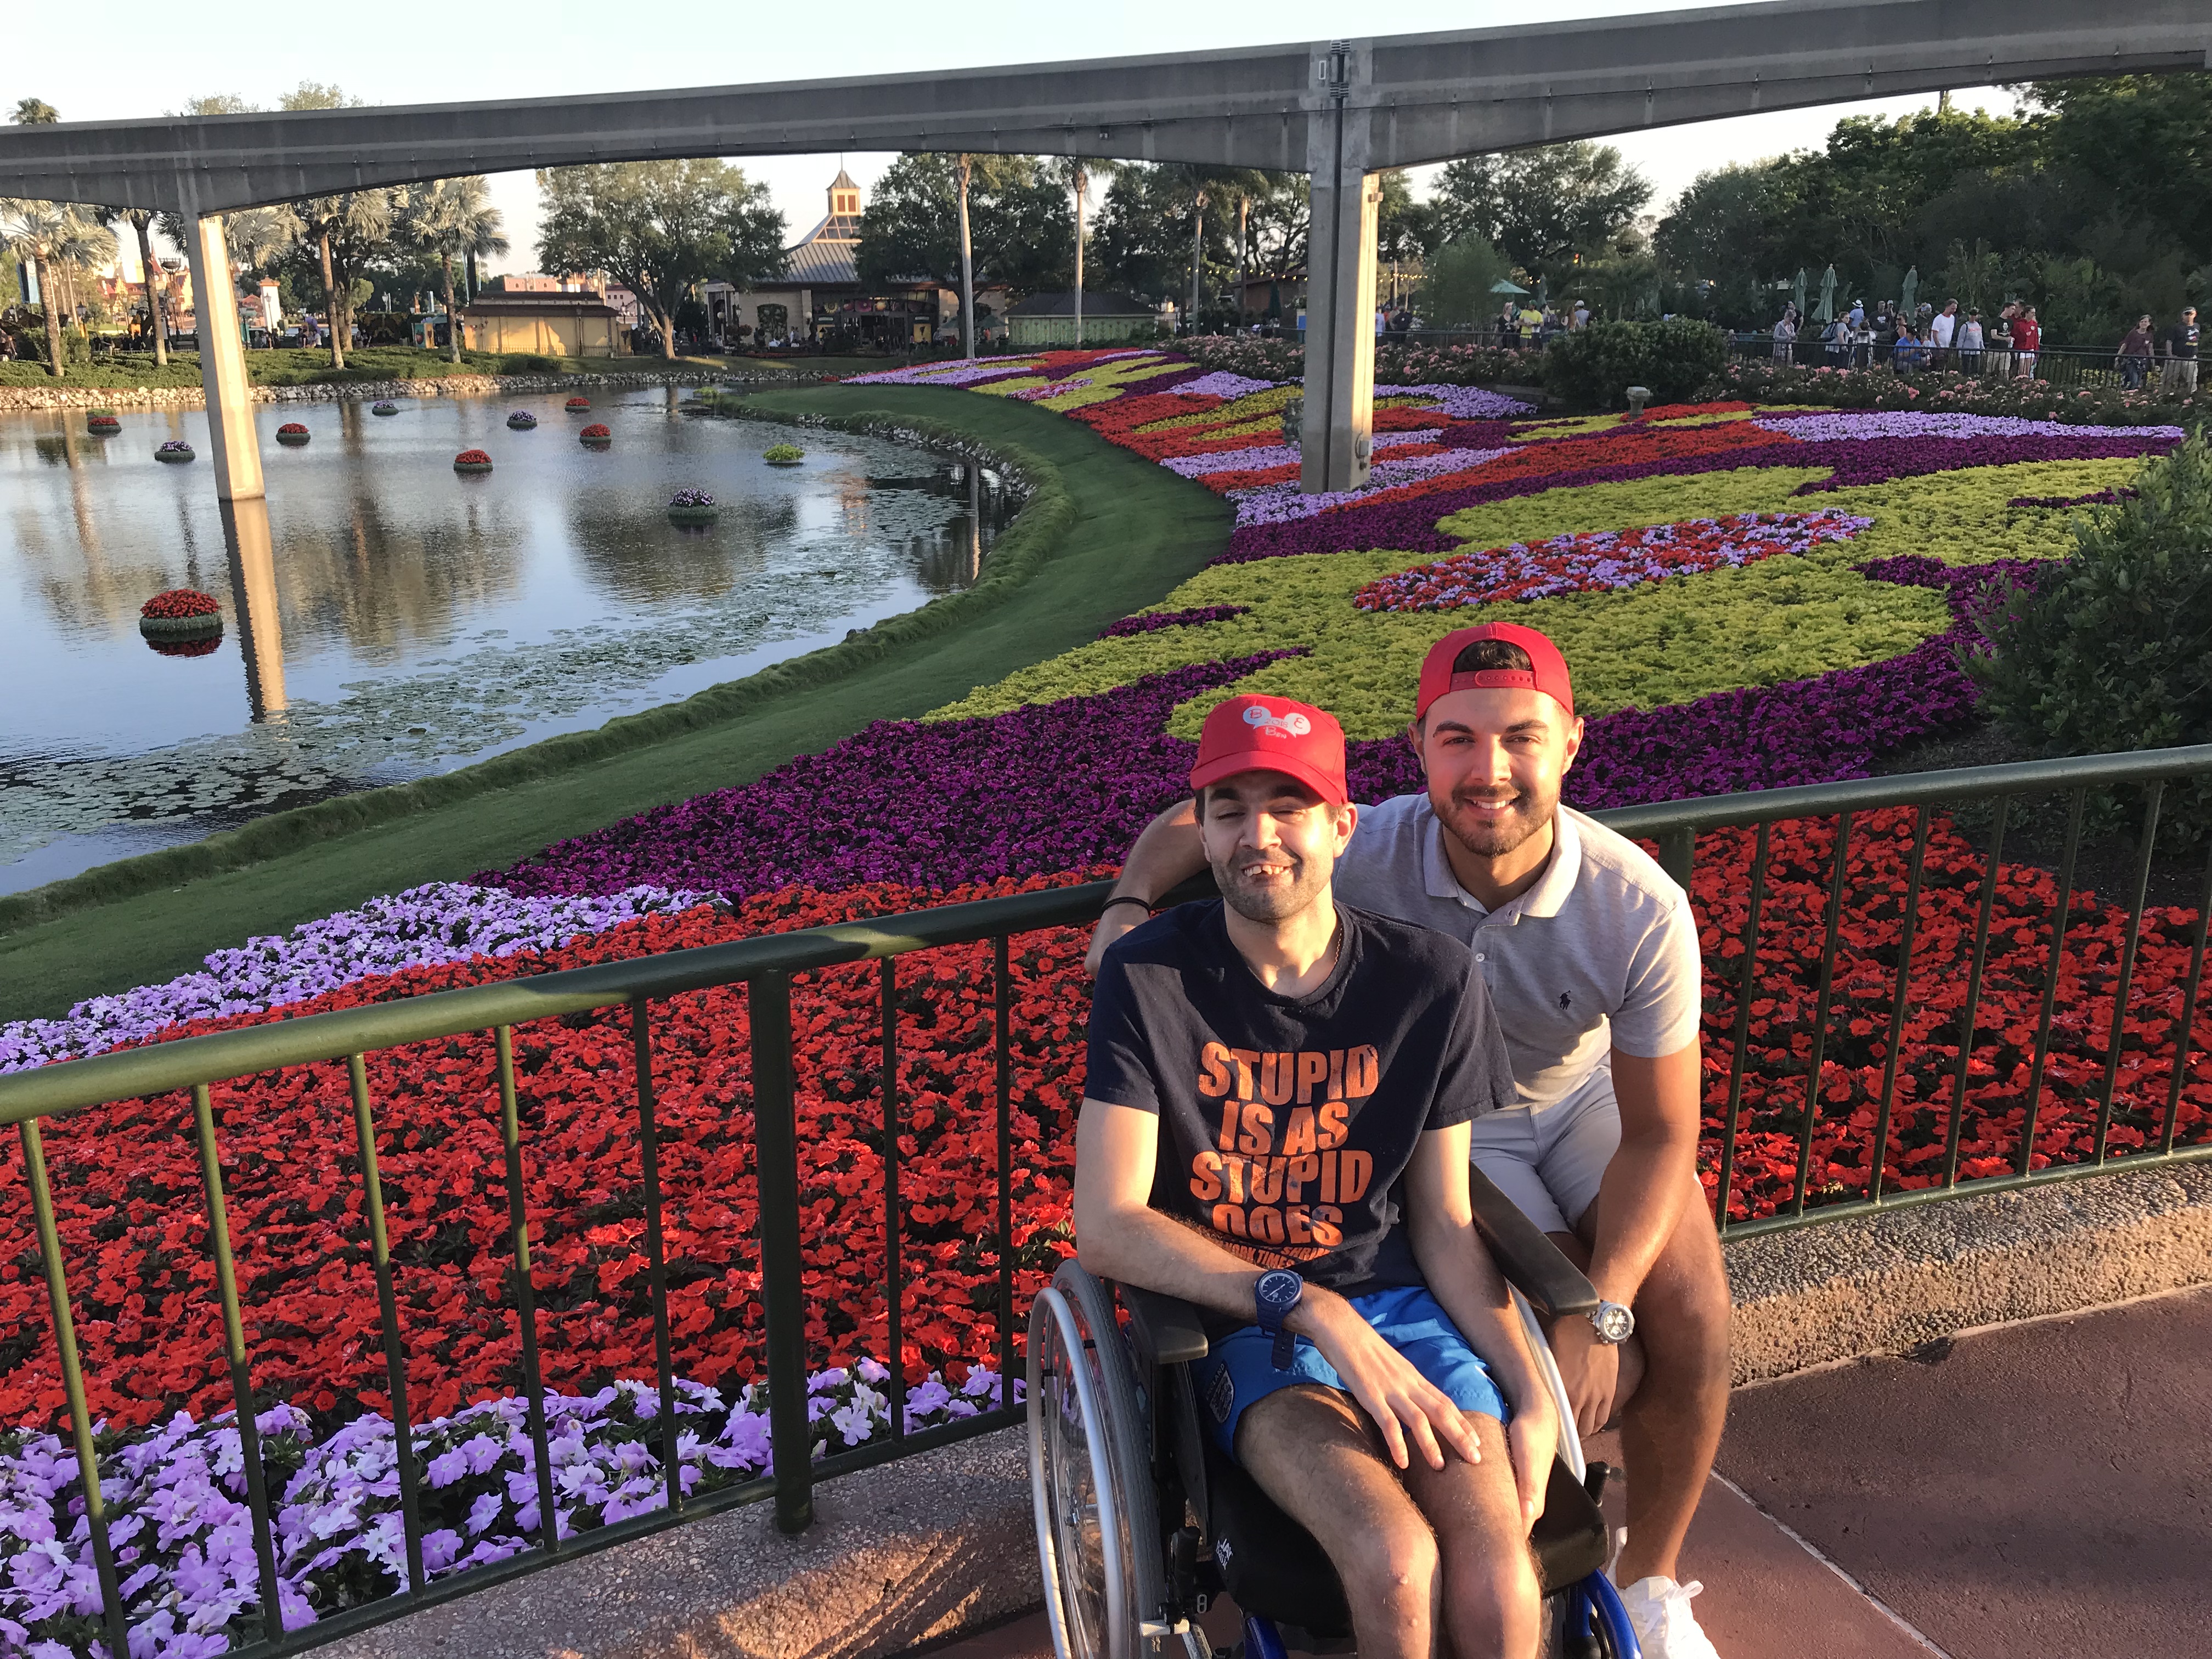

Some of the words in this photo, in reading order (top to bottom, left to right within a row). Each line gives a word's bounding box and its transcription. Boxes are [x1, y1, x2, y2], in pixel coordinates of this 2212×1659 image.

[1264, 719, 1288, 728] 2018
[1199, 1042, 1379, 1105] STUPID
[1219, 1101, 1273, 1155] IS
[1283, 1102, 1348, 1155] AS
[1190, 1150, 1373, 1204] STUPID
[1213, 1204, 1342, 1246] DOES
[1281, 1246, 1334, 1261] SHRIM
